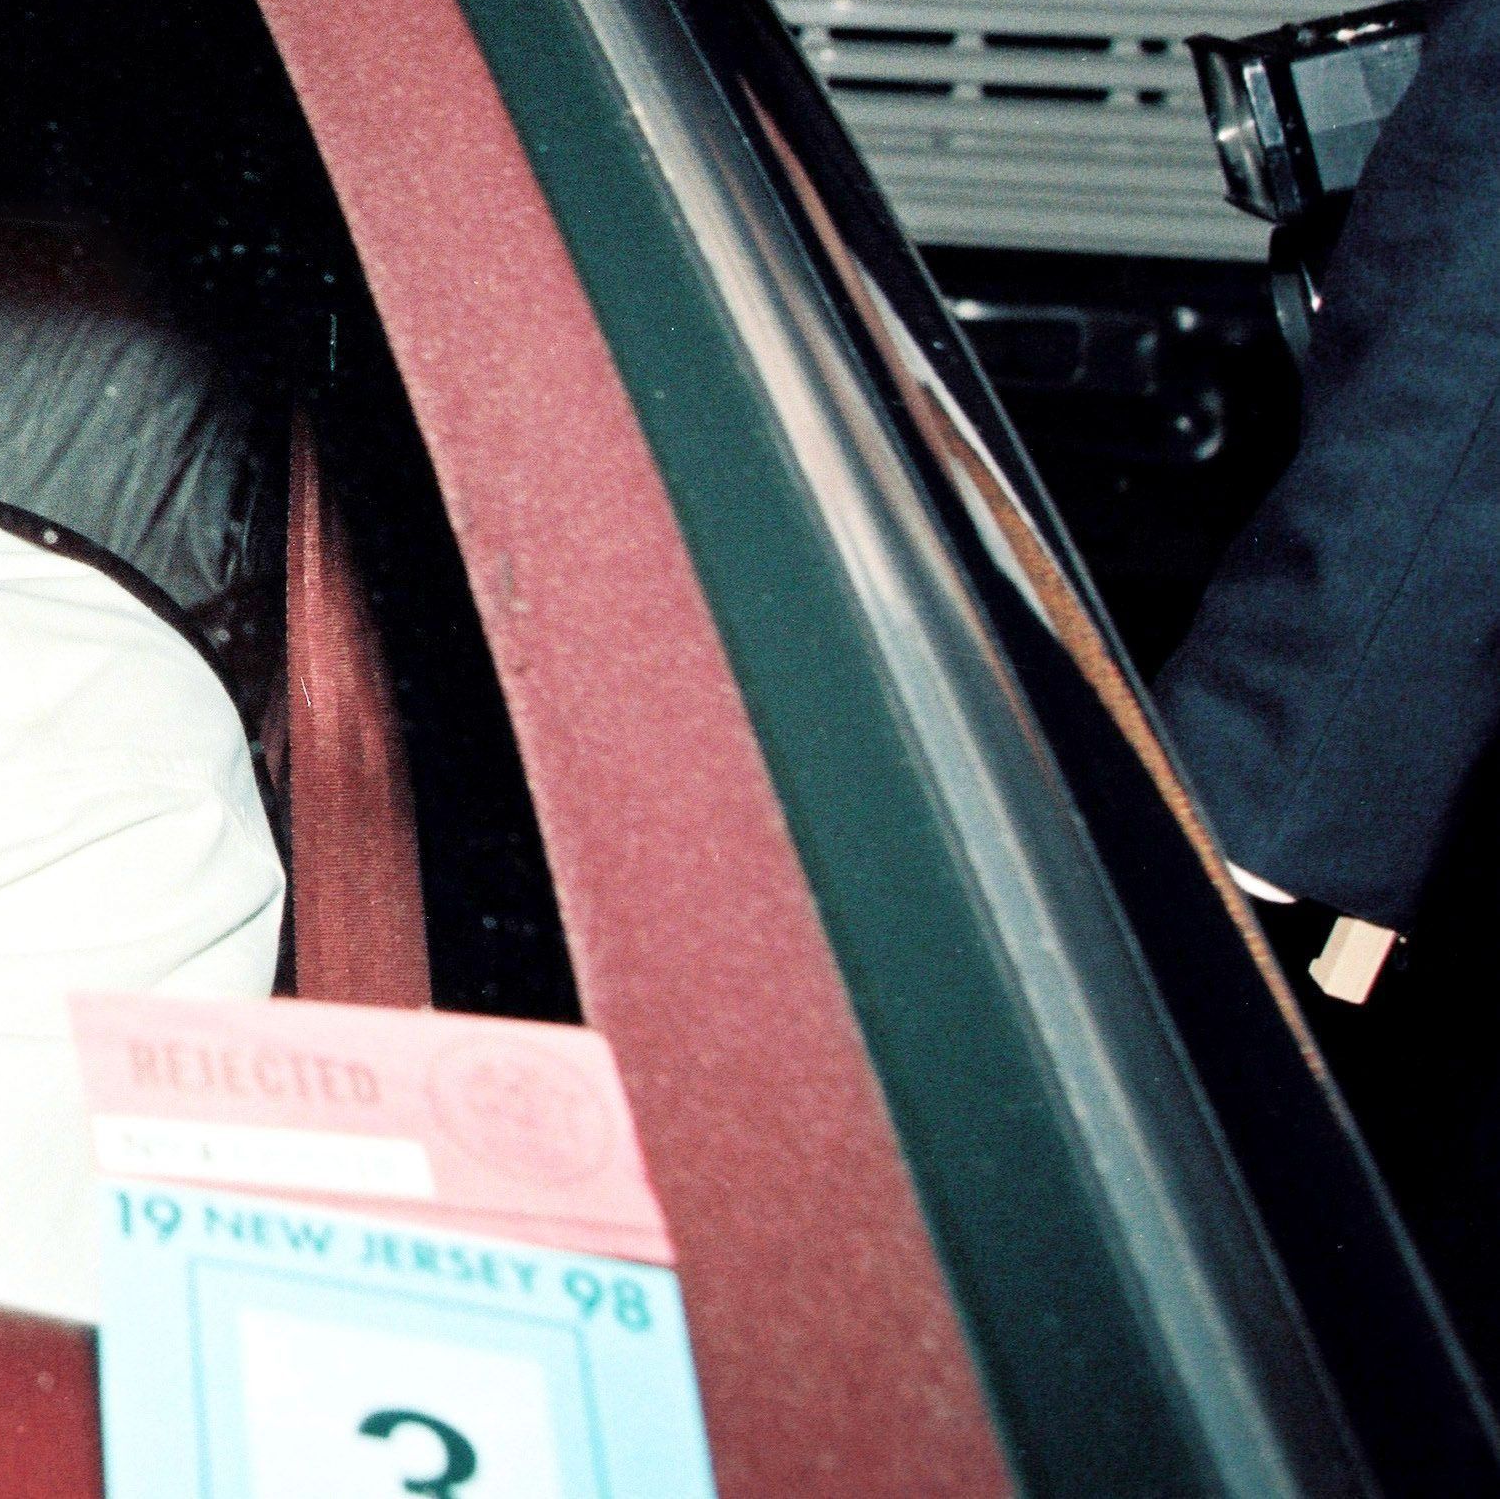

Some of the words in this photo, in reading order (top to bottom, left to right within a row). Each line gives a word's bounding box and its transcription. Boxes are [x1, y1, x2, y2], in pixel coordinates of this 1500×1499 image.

[128, 1040, 381, 1107] REJECTED
[116, 1190, 183, 1244] 19
[203, 1203, 334, 1257] NEW
[361, 1232, 541, 1293] JERSEY
[561, 1264, 654, 1334] 98
